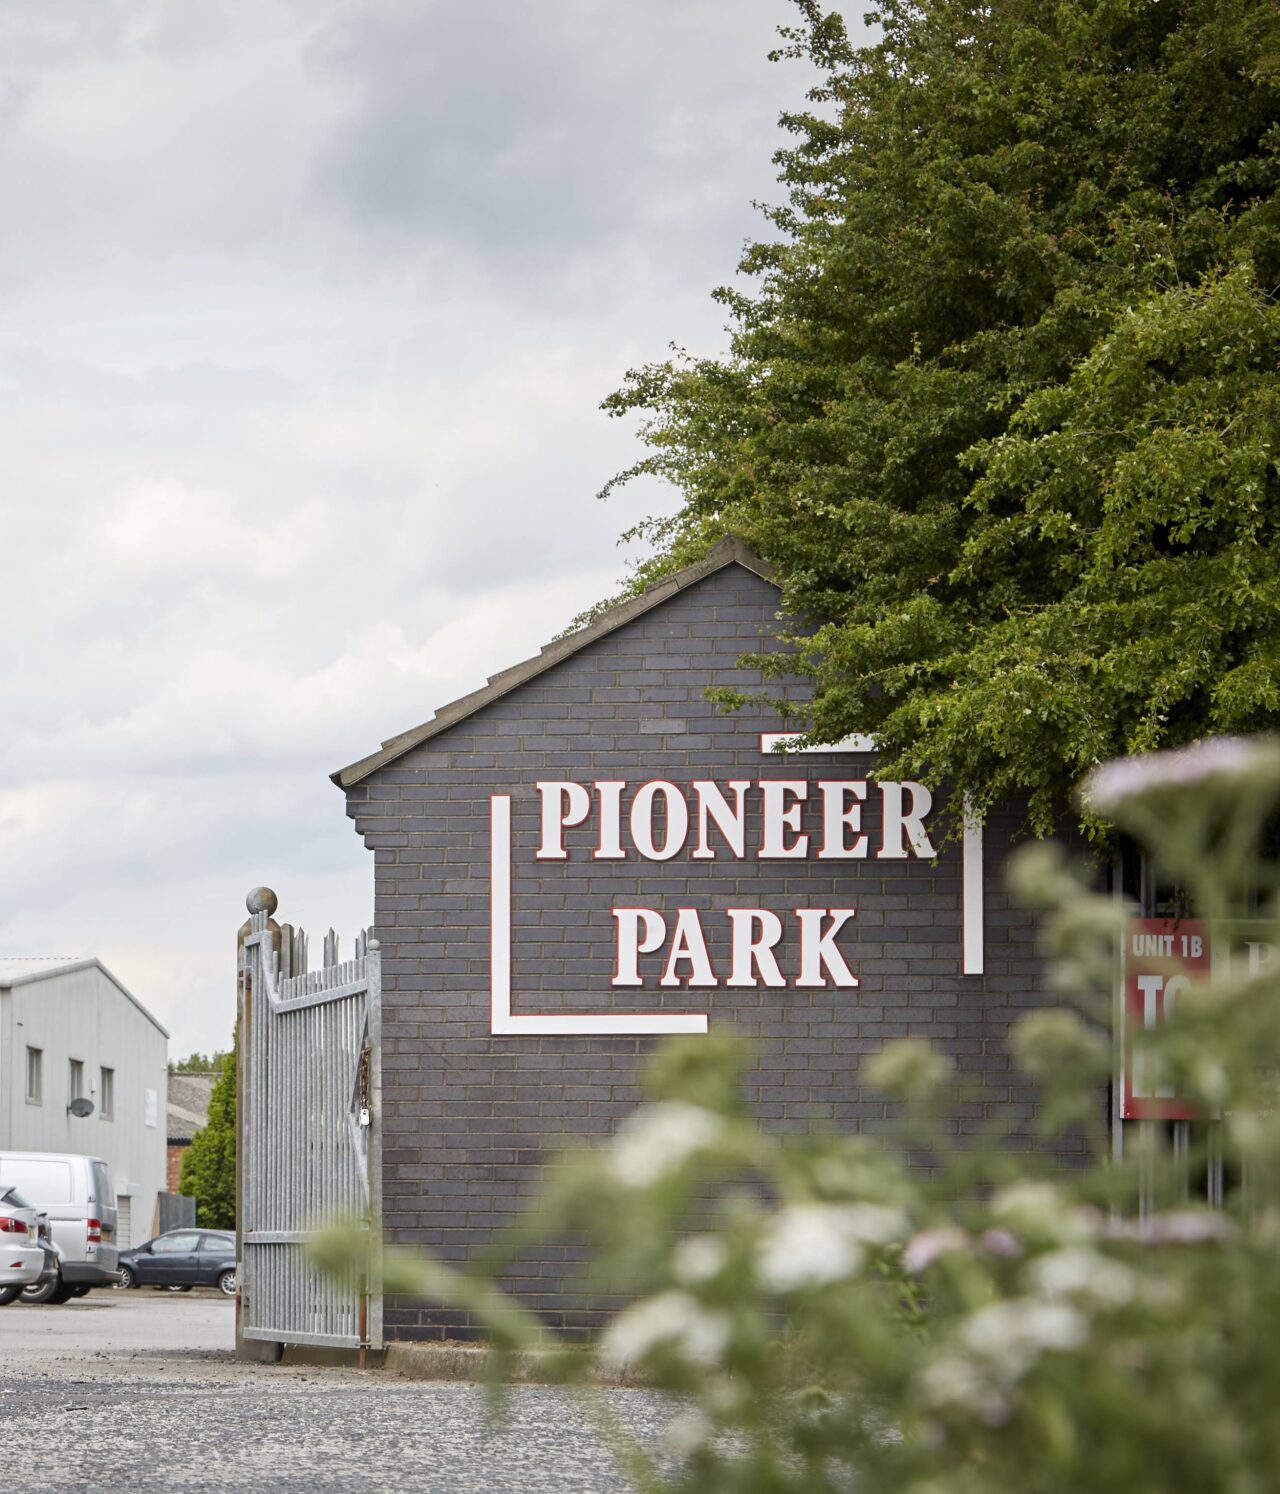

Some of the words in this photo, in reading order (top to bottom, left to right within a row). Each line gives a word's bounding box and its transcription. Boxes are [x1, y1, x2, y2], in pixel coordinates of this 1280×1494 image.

[535, 779, 937, 862] PIONEER
[612, 907, 860, 988] PARK
[1132, 934, 1175, 957] UNIT
[1181, 935, 1203, 959] 1B
